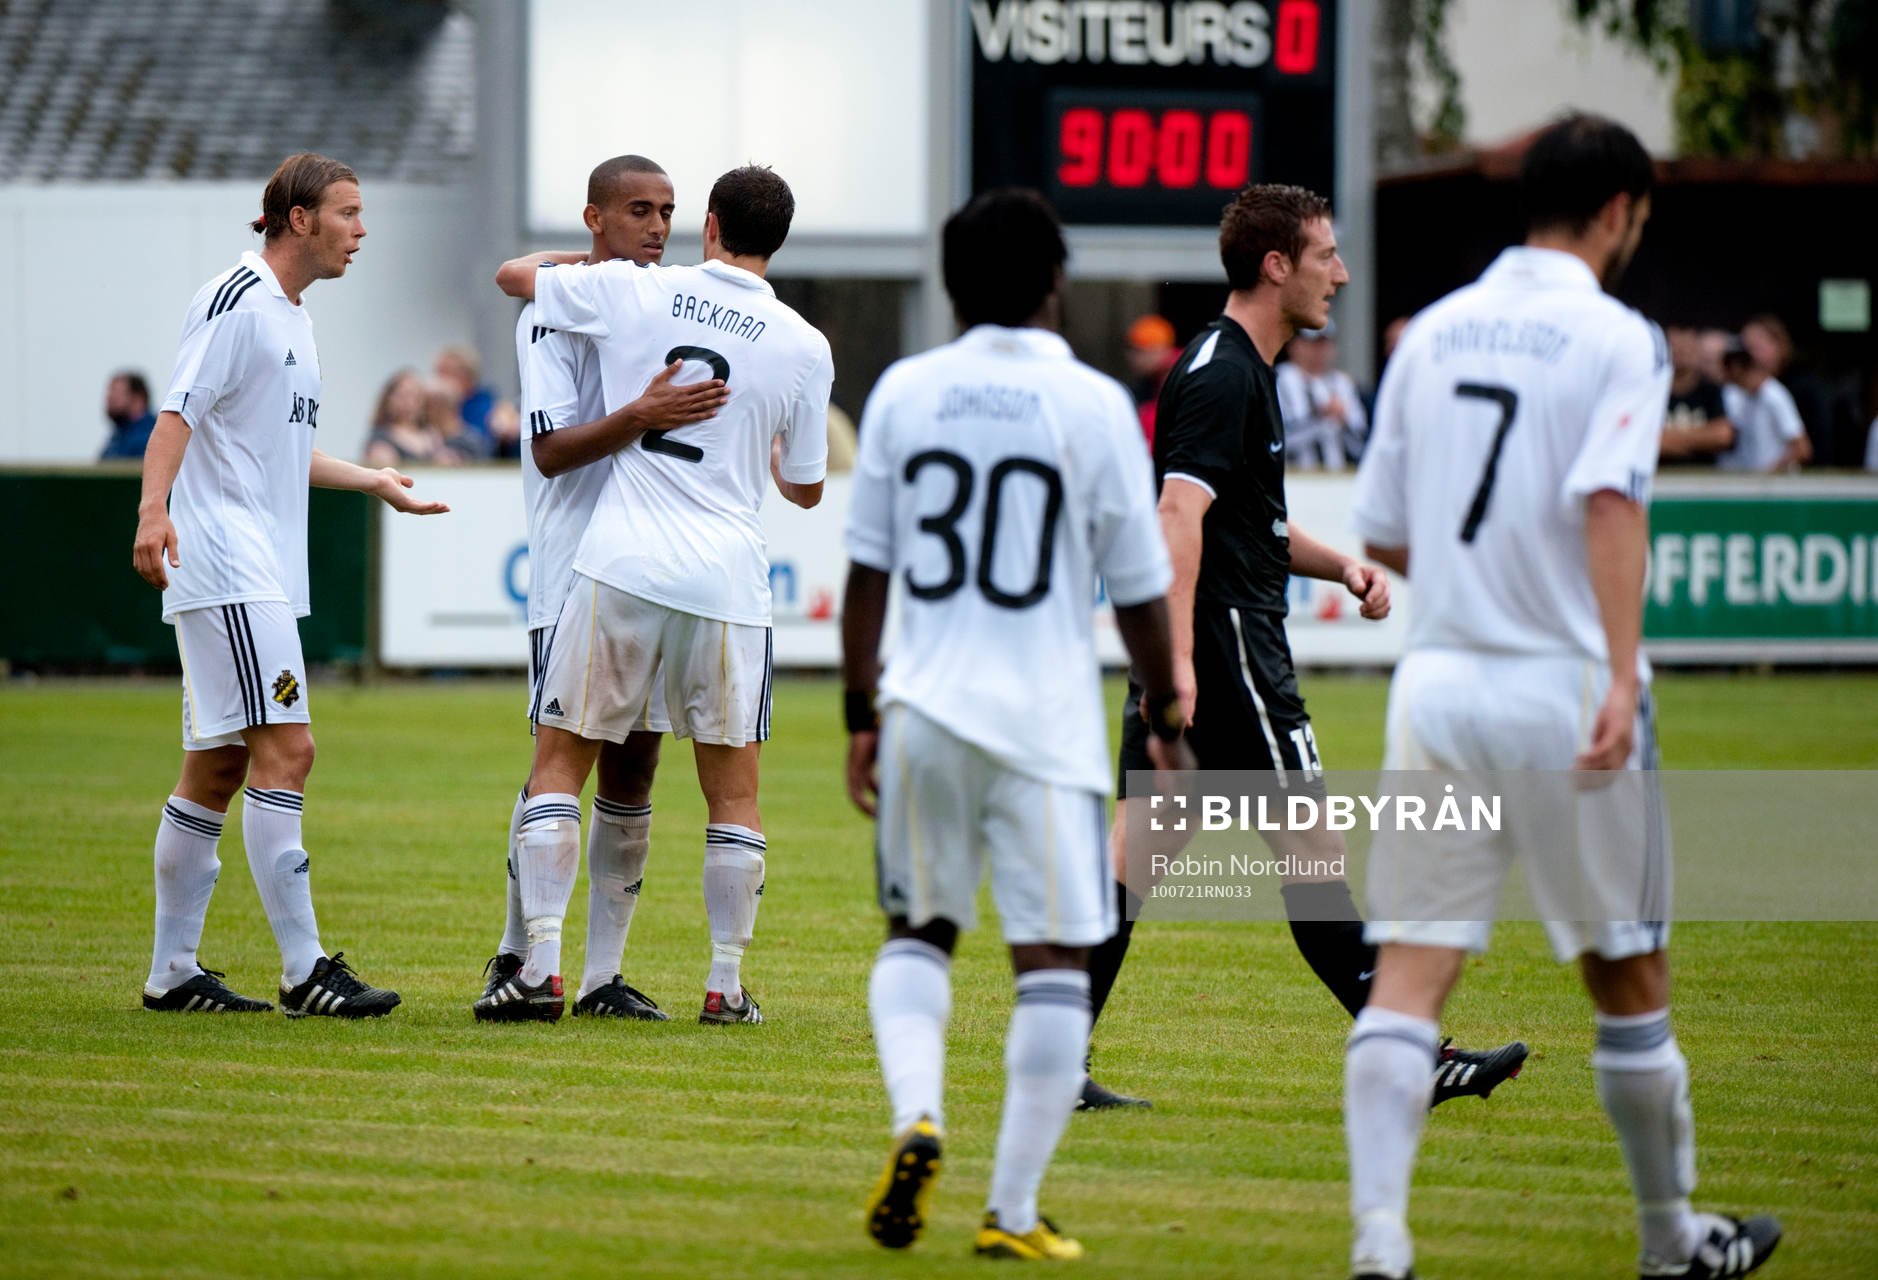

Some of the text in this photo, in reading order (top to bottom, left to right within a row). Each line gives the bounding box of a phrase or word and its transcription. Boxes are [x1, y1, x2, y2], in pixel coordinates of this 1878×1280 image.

[971, 1, 1320, 74] VISITEURS 0
[671, 293, 766, 342] BACKMAN
[641, 345, 730, 463] 2
[1452, 382, 1519, 544] 7
[903, 449, 1064, 611] 30
[1645, 532, 1878, 606] FFERDI
[1289, 723, 1323, 783] 13
